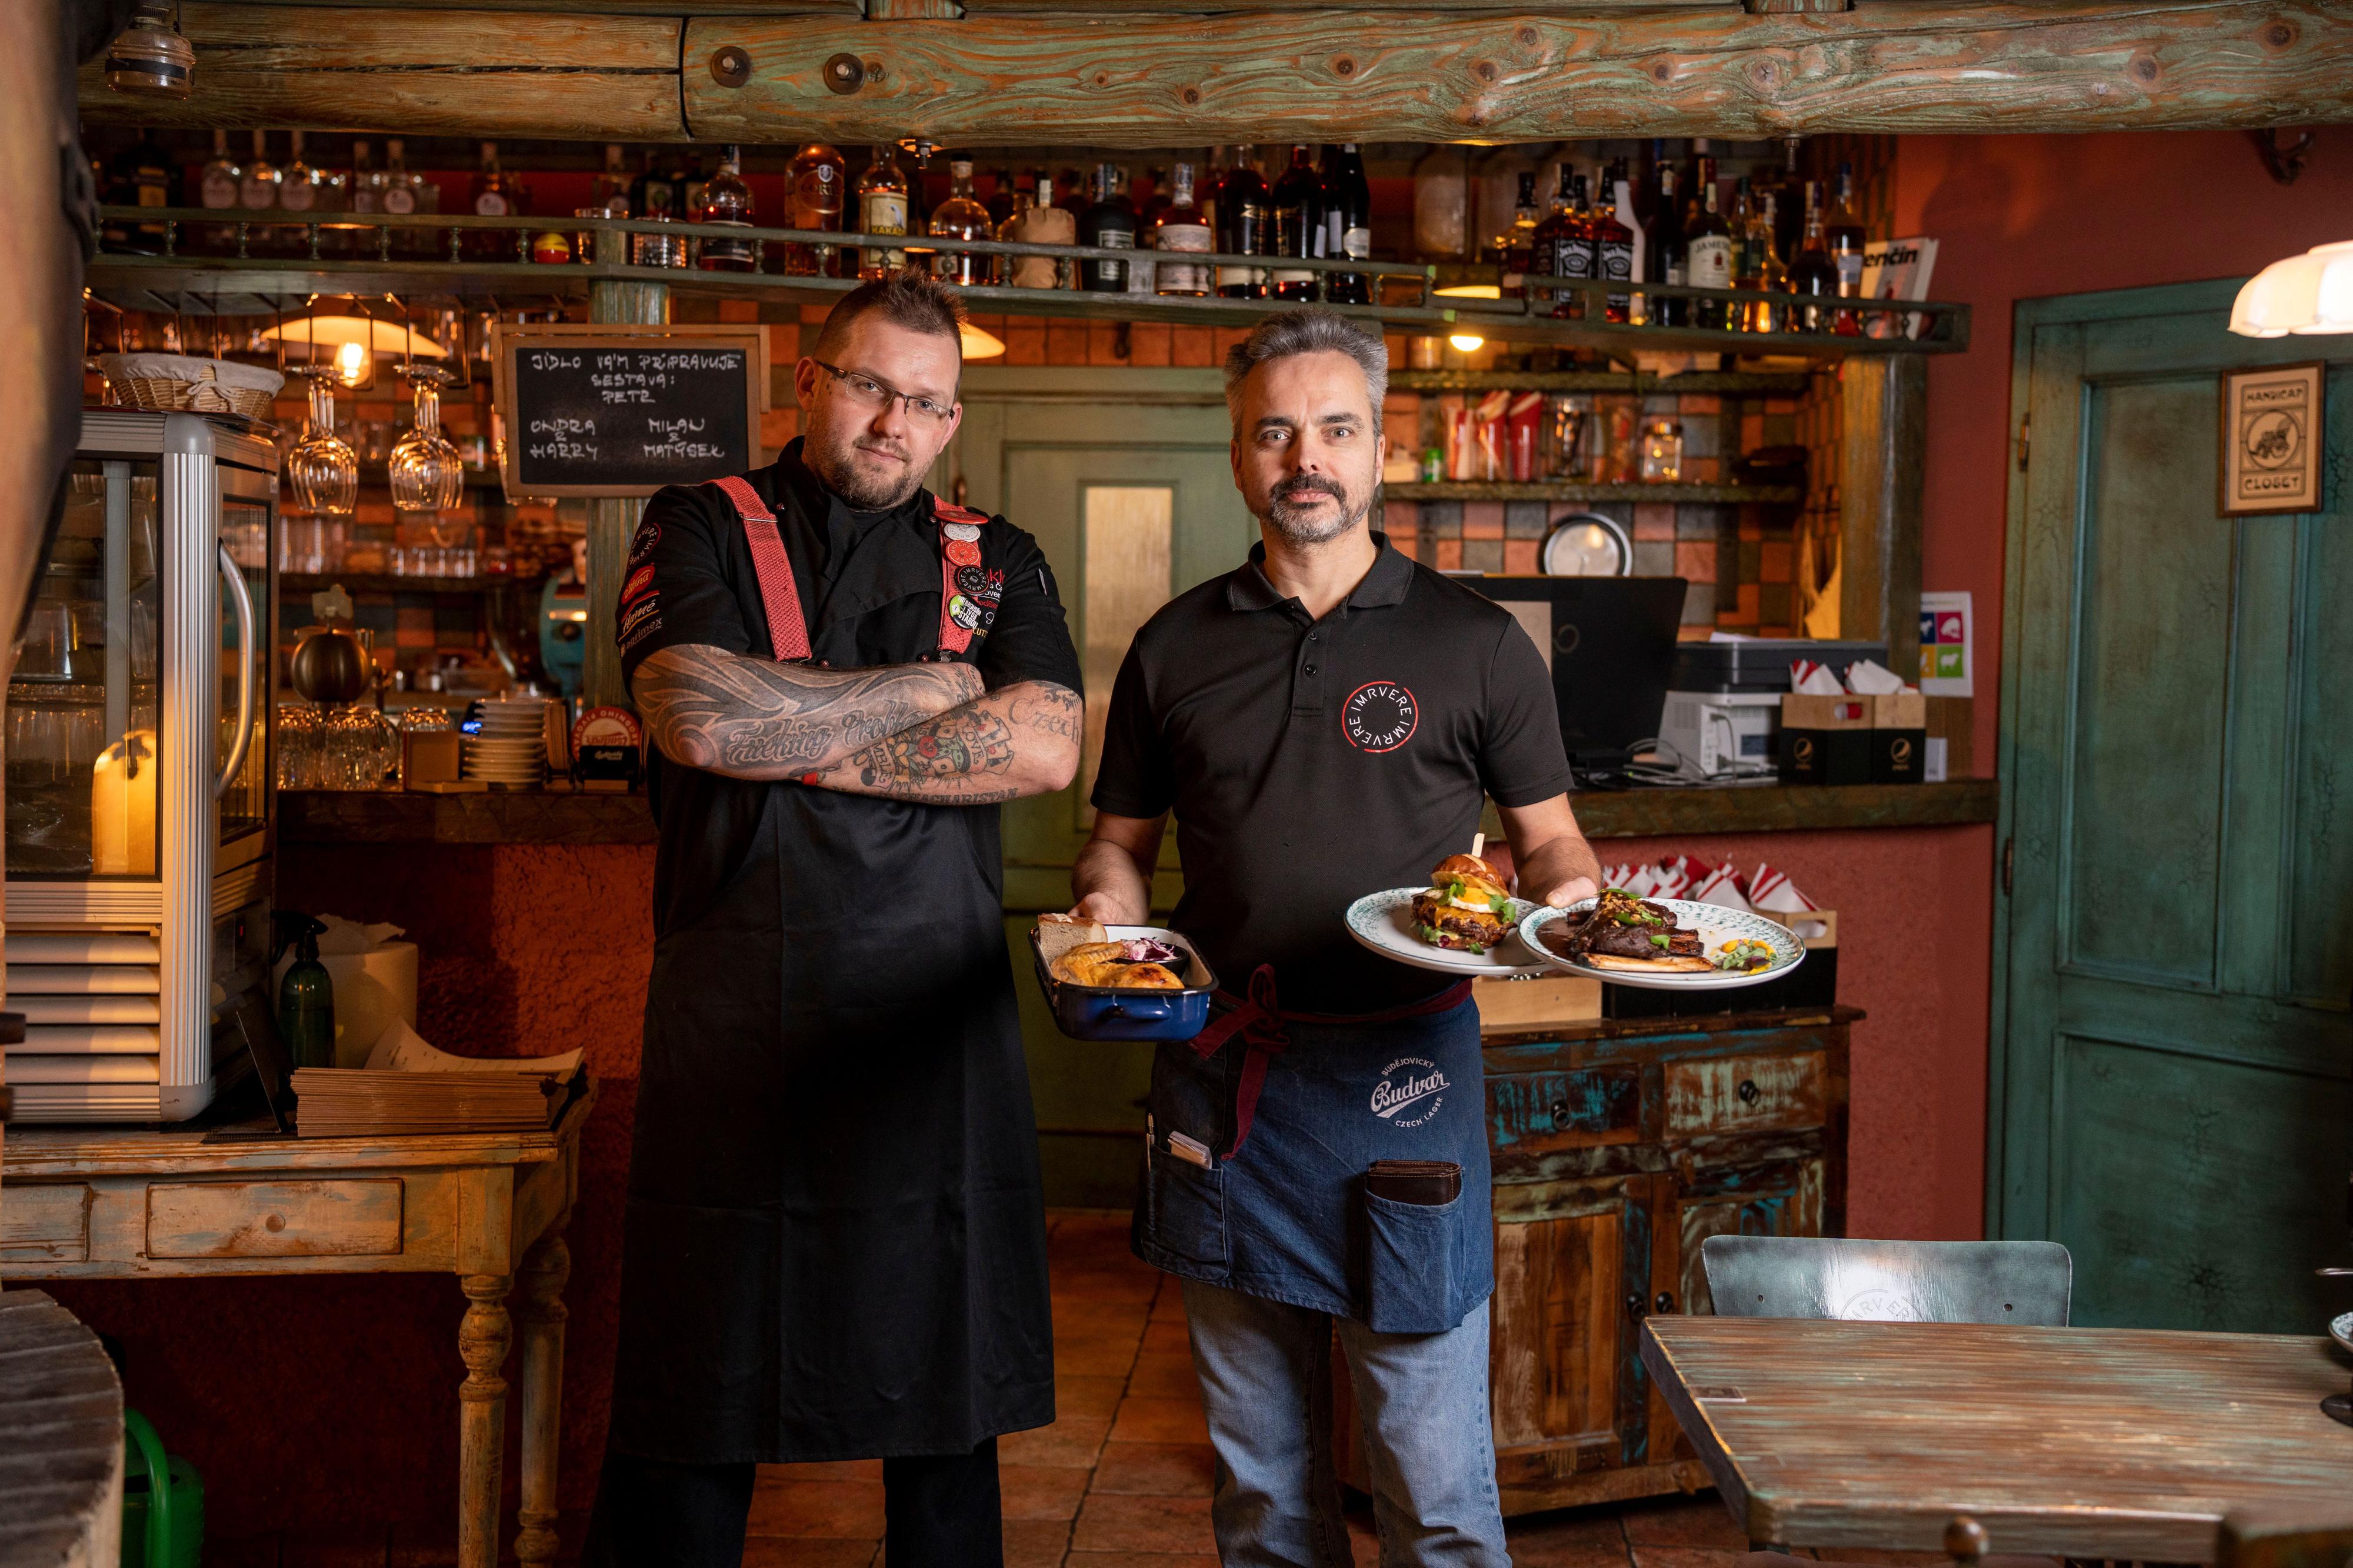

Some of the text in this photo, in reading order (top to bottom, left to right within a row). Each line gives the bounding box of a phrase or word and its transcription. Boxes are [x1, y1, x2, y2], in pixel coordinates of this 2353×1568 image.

[531, 352, 581, 371] JÍDLO
[597, 354, 628, 371] VÁM
[602, 390, 655, 404] PETR
[531, 419, 595, 435] ONDRA
[648, 418, 705, 433] MILAN
[530, 442, 598, 460] HARRY
[1351, 686, 1412, 716] IMRVERE
[1349, 716, 1410, 746] IMRVERE
[1381, 1057, 1435, 1076] BUDĚJOVICKÝ
[1371, 1070, 1451, 1113] Budvar
[1395, 1097, 1443, 1127] CZECH LAGER
